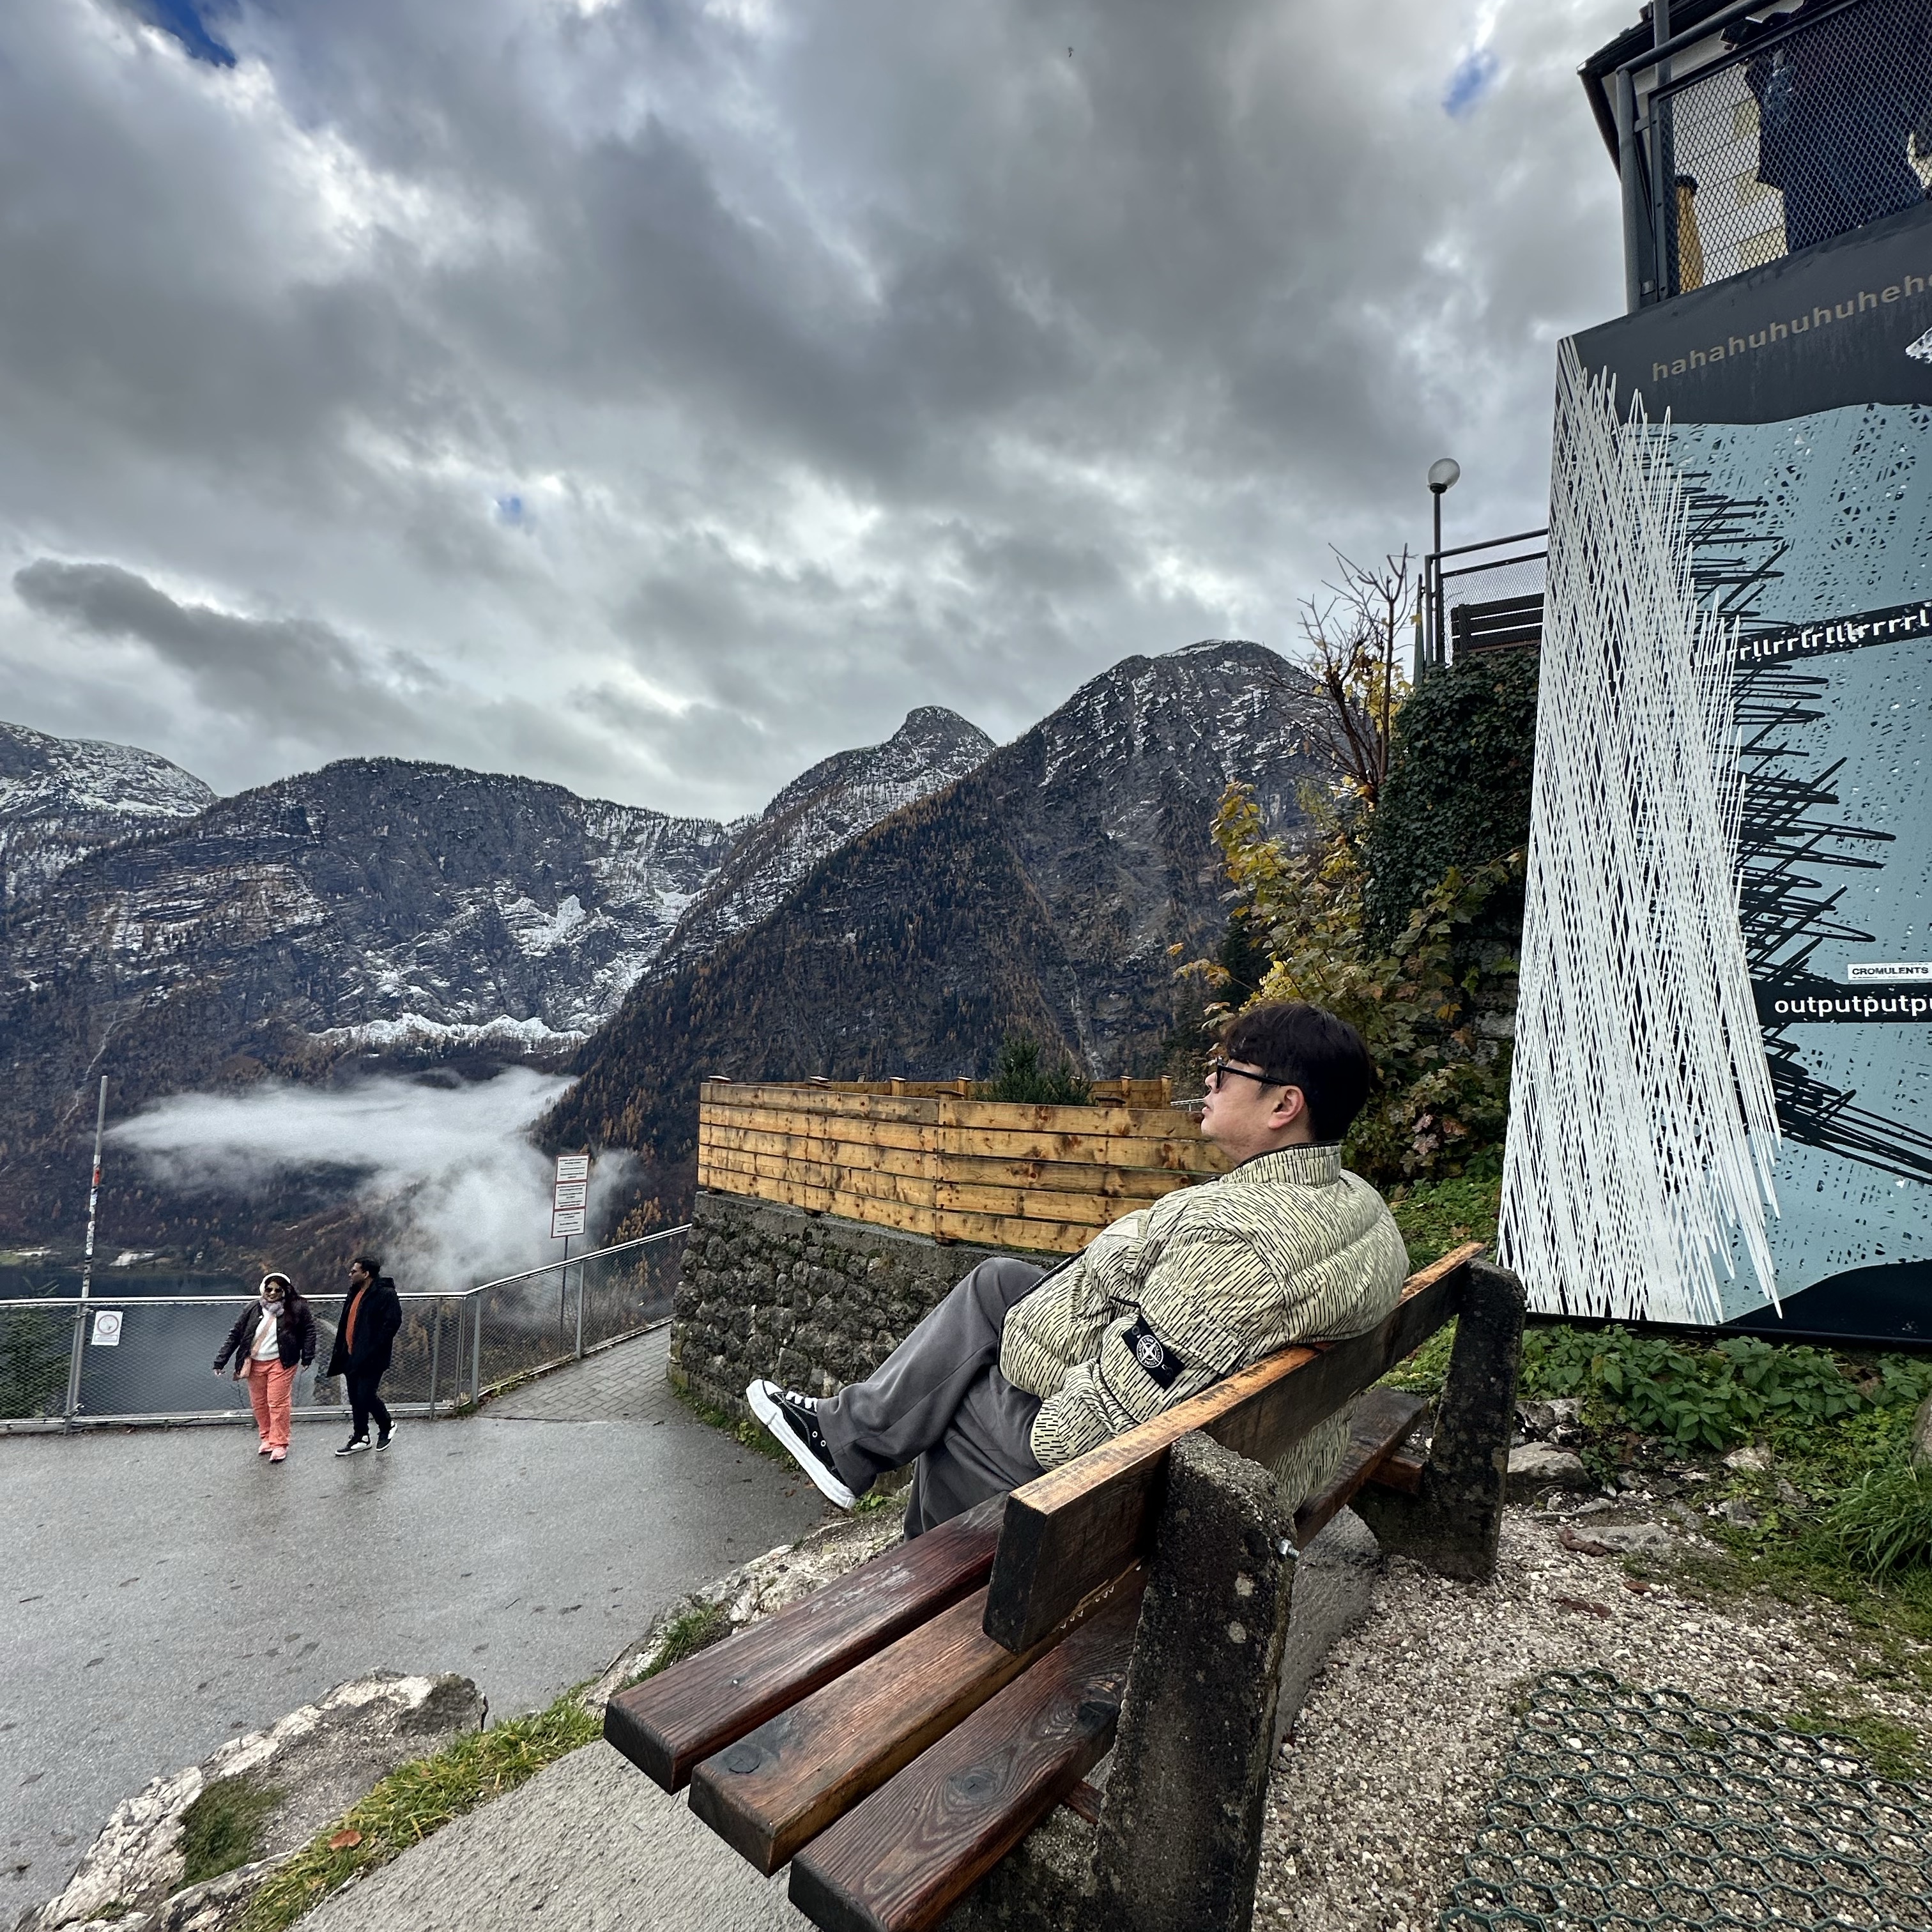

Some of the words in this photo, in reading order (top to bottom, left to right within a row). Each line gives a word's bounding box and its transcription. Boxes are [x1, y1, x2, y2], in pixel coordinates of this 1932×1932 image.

[1652, 275, 1932, 381] hahahuhuhuheh
[1852, 967, 1929, 975] CROMULENTS
[1774, 995, 1932, 1017] outputputp
